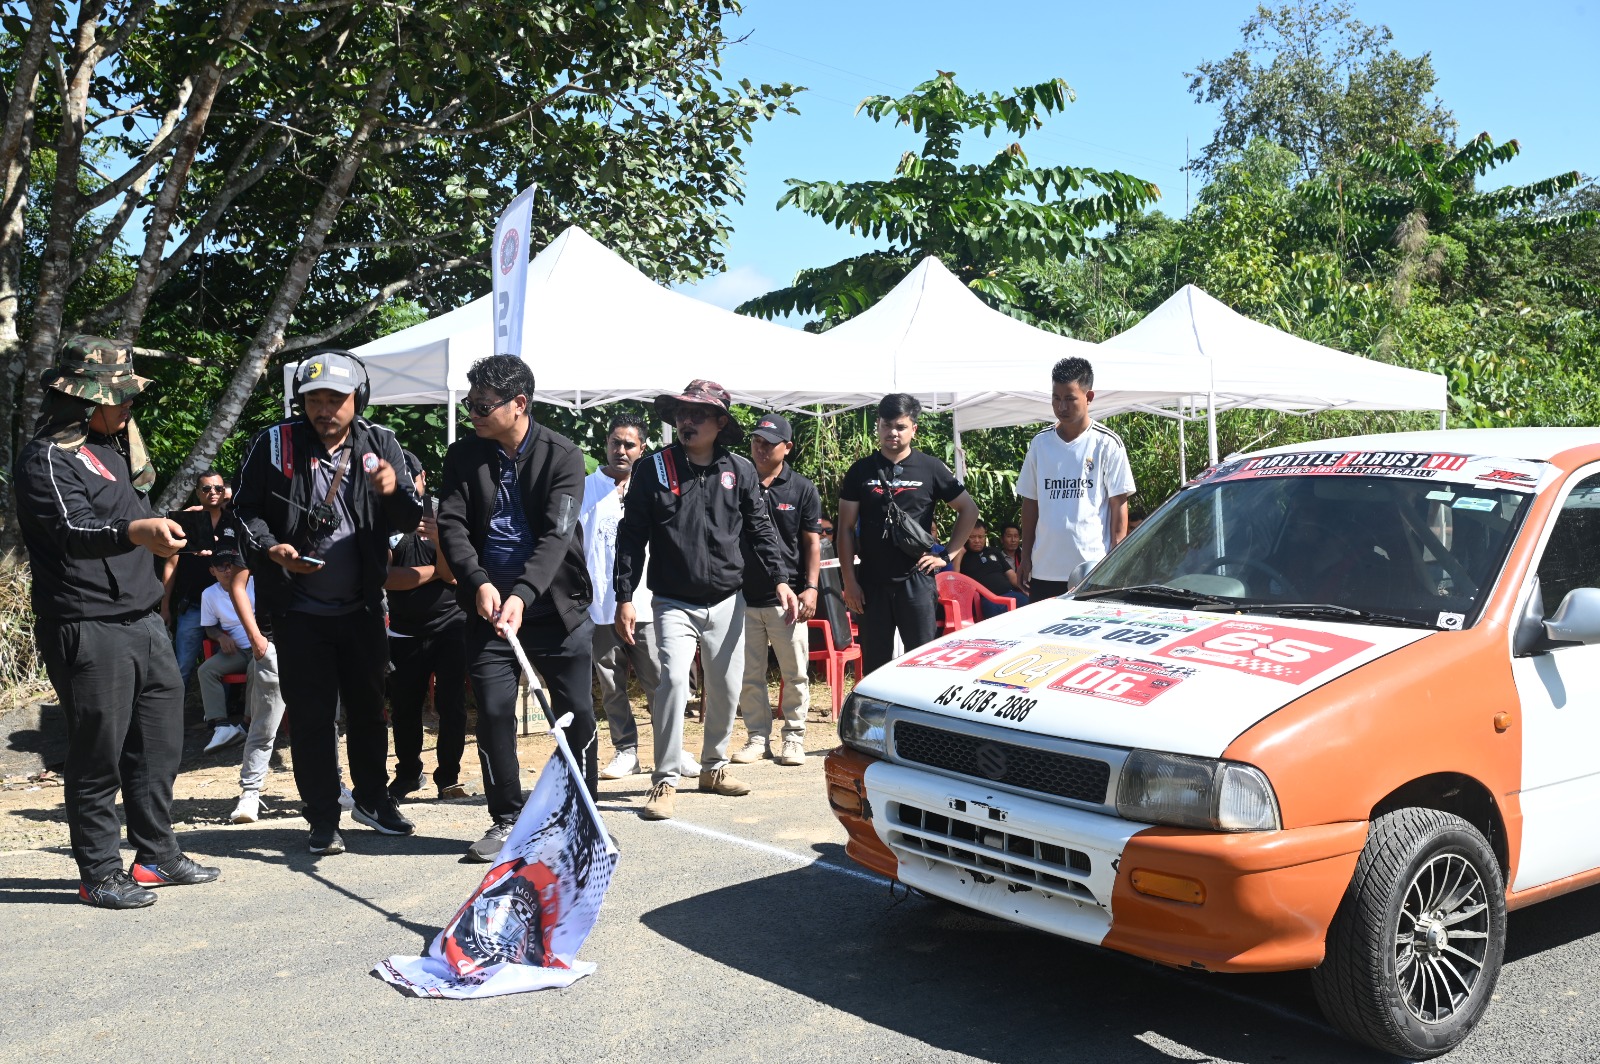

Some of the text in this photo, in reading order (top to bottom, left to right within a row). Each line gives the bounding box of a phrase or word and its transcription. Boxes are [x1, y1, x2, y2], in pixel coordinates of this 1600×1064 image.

[1243, 452, 1466, 471] THROTTLE THRUST VII
[1336, 466, 1360, 474] FULL
[1359, 466, 1403, 476] TARMAC
[1402, 469, 1438, 478] RALLY
[1044, 477, 1094, 490] Emirates
[1050, 488, 1085, 500] FLY BETTER
[1037, 623, 1102, 637] 068
[1101, 628, 1170, 645] 026
[1202, 631, 1334, 664] 65
[913, 648, 980, 666] 49
[993, 654, 1070, 683] 04
[1062, 666, 1147, 696] 06
[933, 685, 964, 706] AS
[993, 695, 1038, 722] 2888
